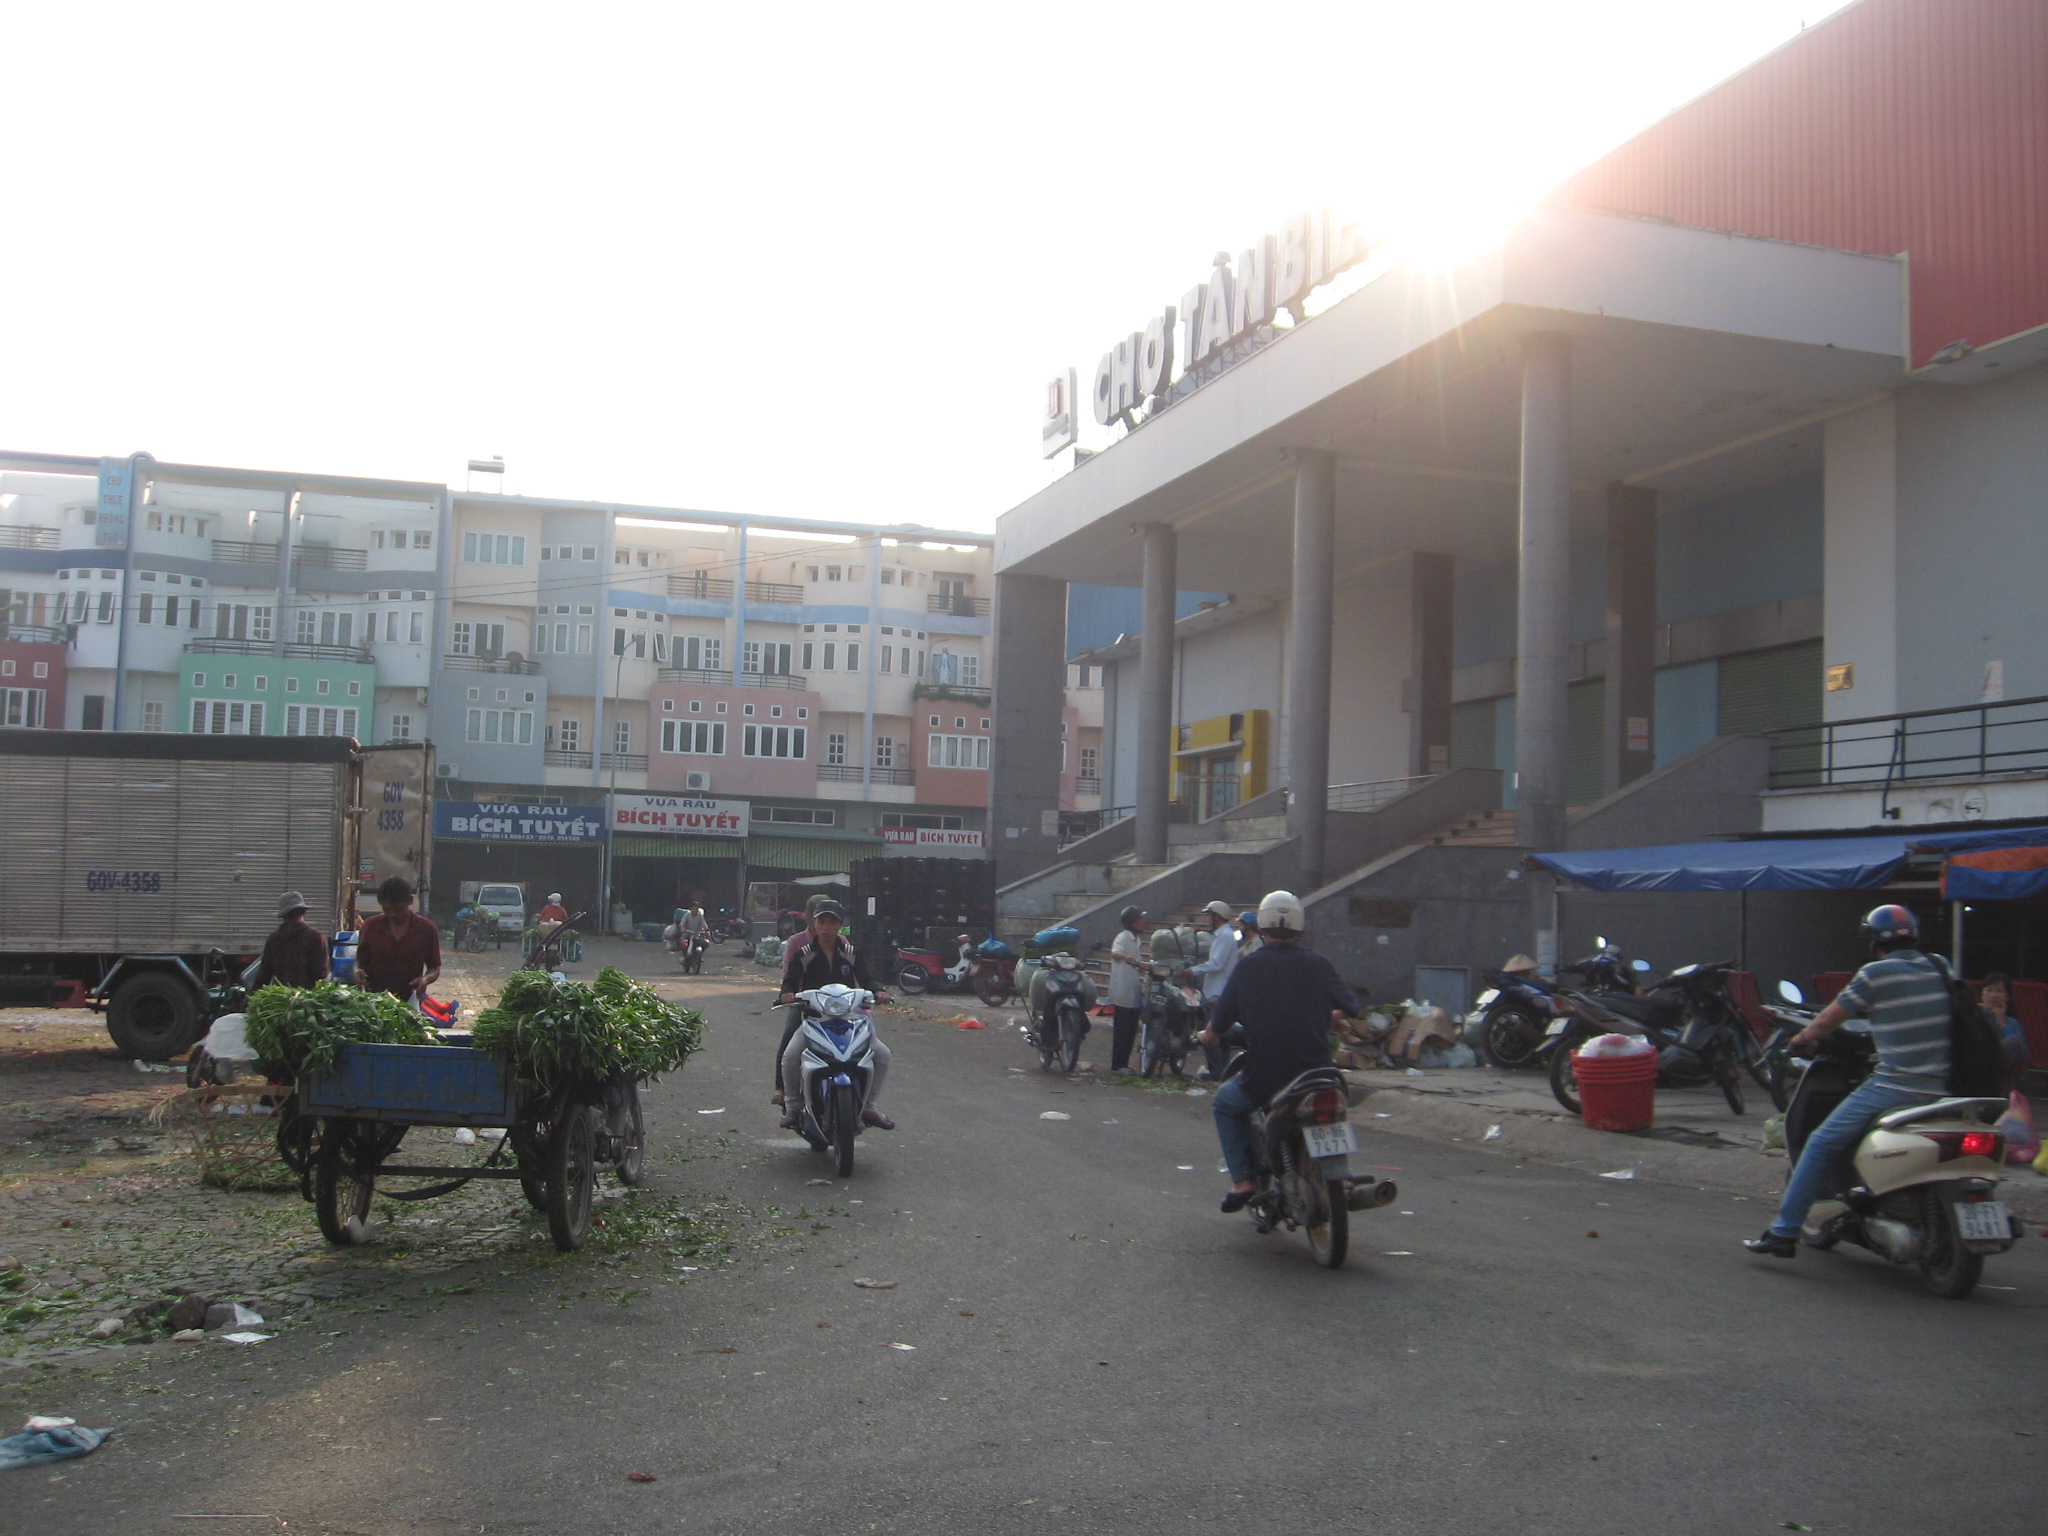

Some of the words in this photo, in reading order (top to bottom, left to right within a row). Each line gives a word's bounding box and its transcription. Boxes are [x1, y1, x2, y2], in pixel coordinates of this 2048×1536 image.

[383, 781, 404, 803] 60V
[644, 796, 678, 808] VỰA
[682, 798, 716, 809] RAU
[377, 809, 404, 830] 4358
[477, 802, 520, 816] VỰA
[527, 805, 568, 816] RAU
[616, 806, 667, 826] BÍCH
[673, 810, 740, 829] TUYẾT
[451, 813, 512, 833] BÍCH
[518, 814, 600, 837] TUYẾT
[900, 831, 915, 842] RAU
[87, 870, 161, 892] 60V-4358
